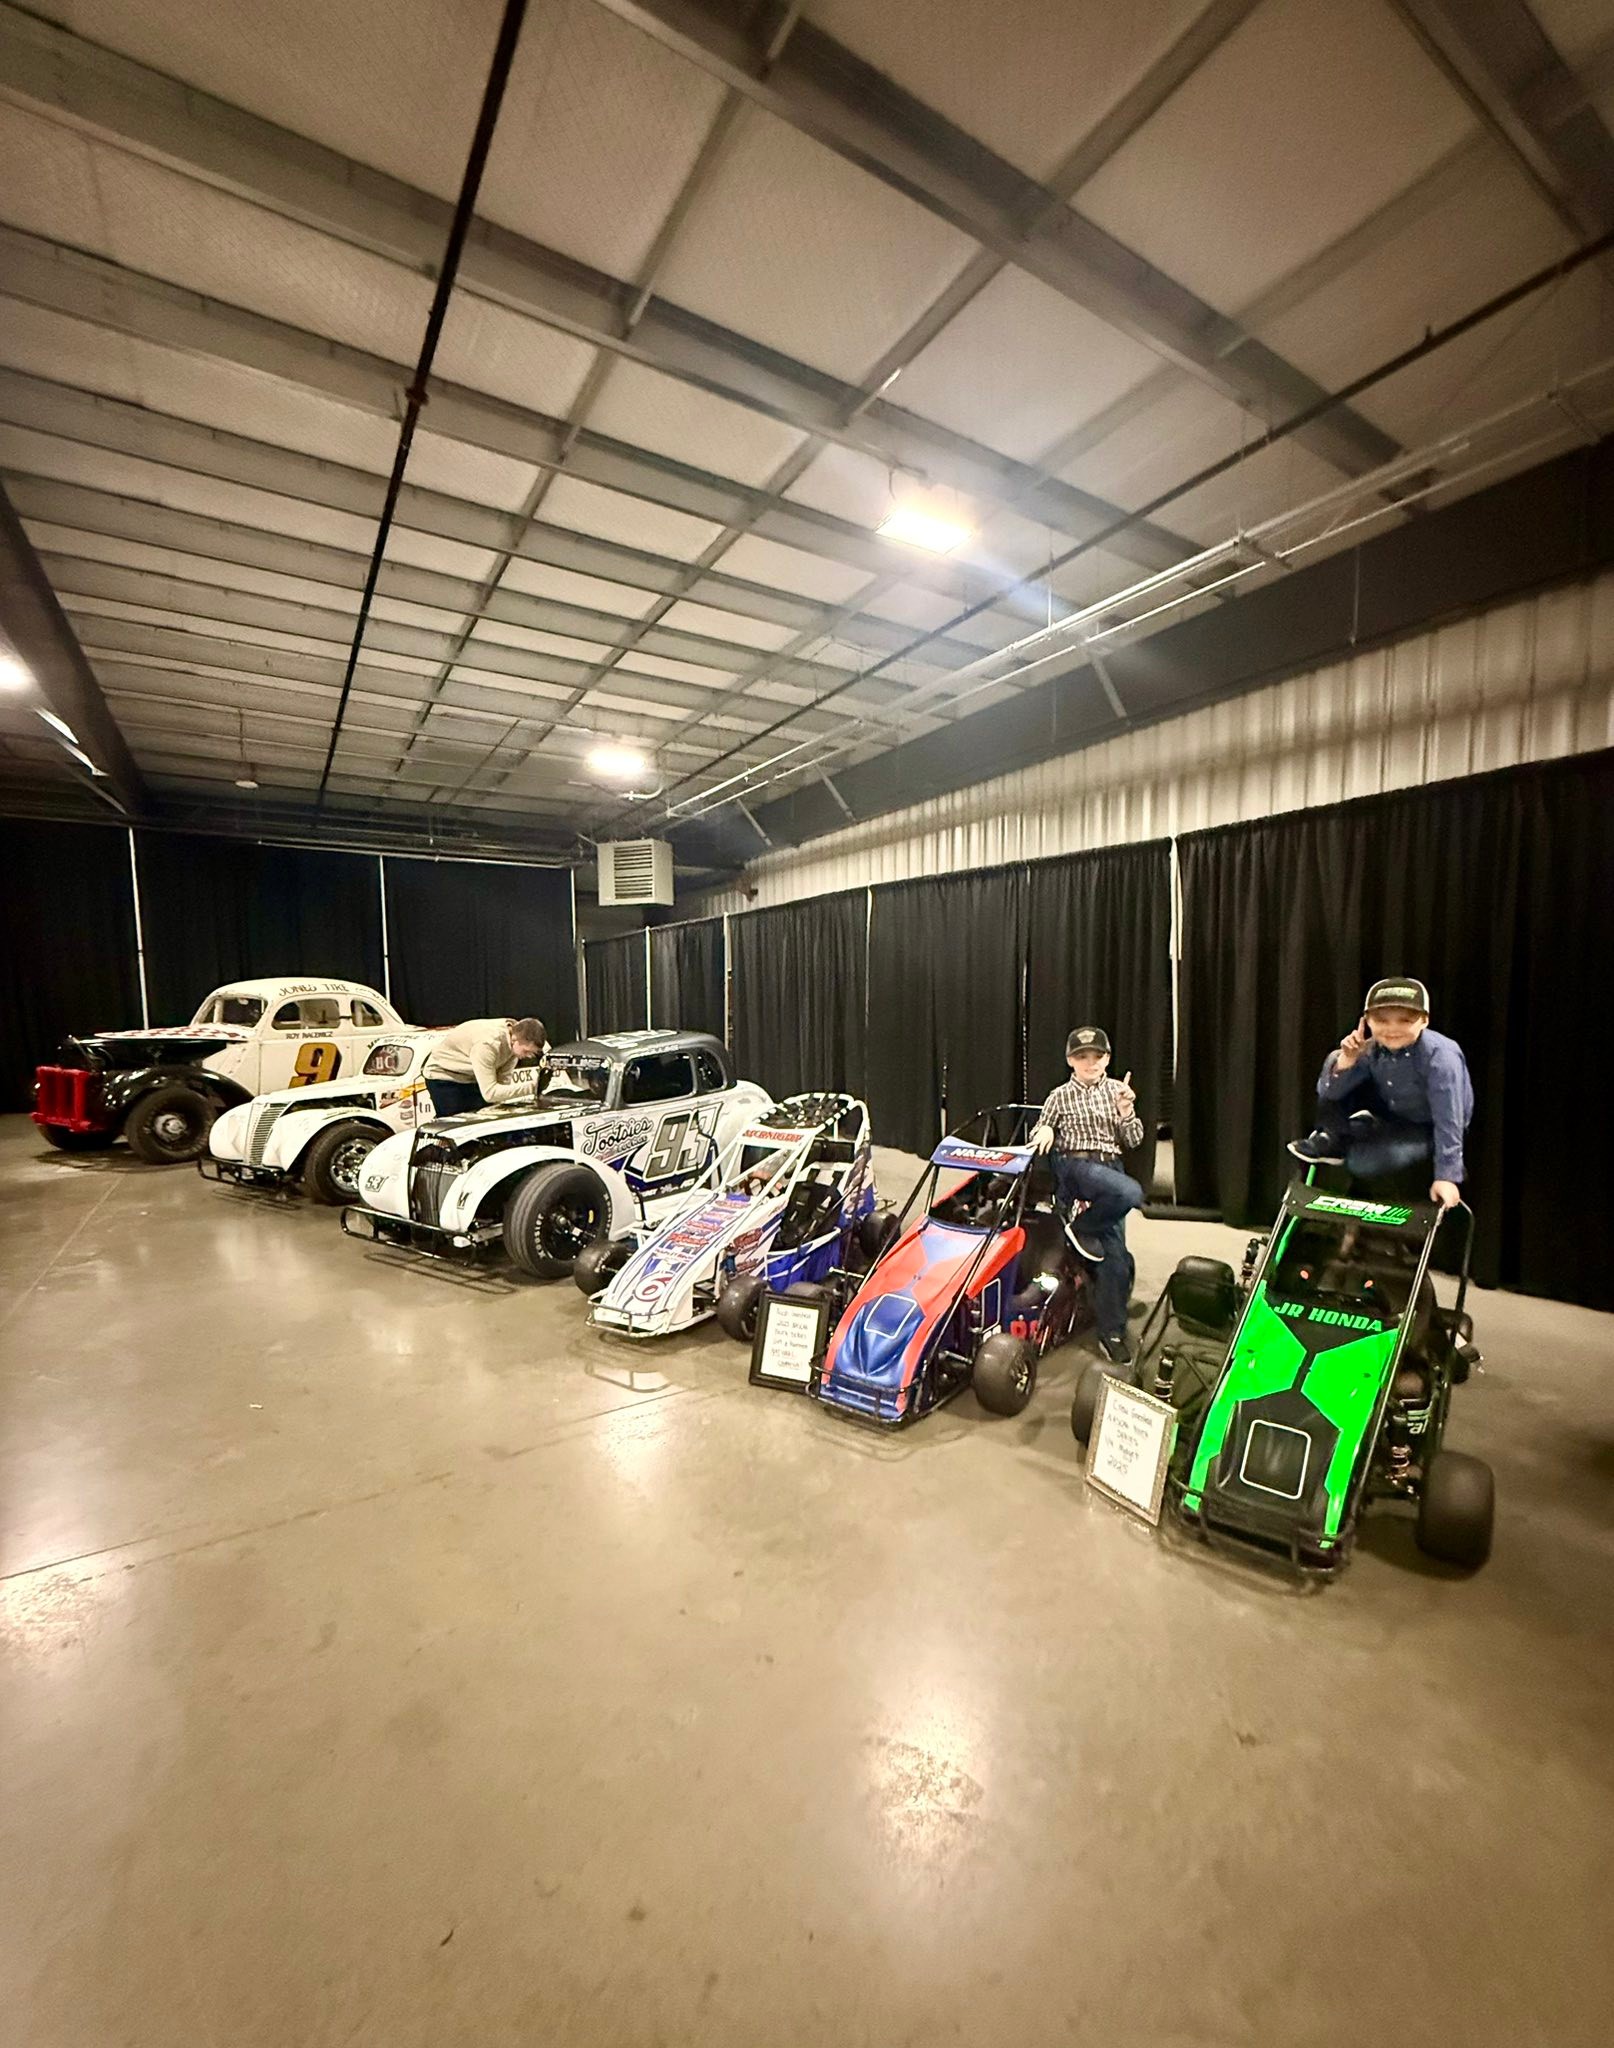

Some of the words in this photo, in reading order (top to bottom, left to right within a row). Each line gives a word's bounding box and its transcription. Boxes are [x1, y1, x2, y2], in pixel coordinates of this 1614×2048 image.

[288, 1042, 342, 1089] 9
[583, 1117, 652, 1156] Tootsies
[644, 1101, 724, 1181] 93
[950, 1147, 1004, 1160] NASH
[1273, 1301, 1305, 1318] JR
[1307, 1307, 1382, 1332] HONDA
